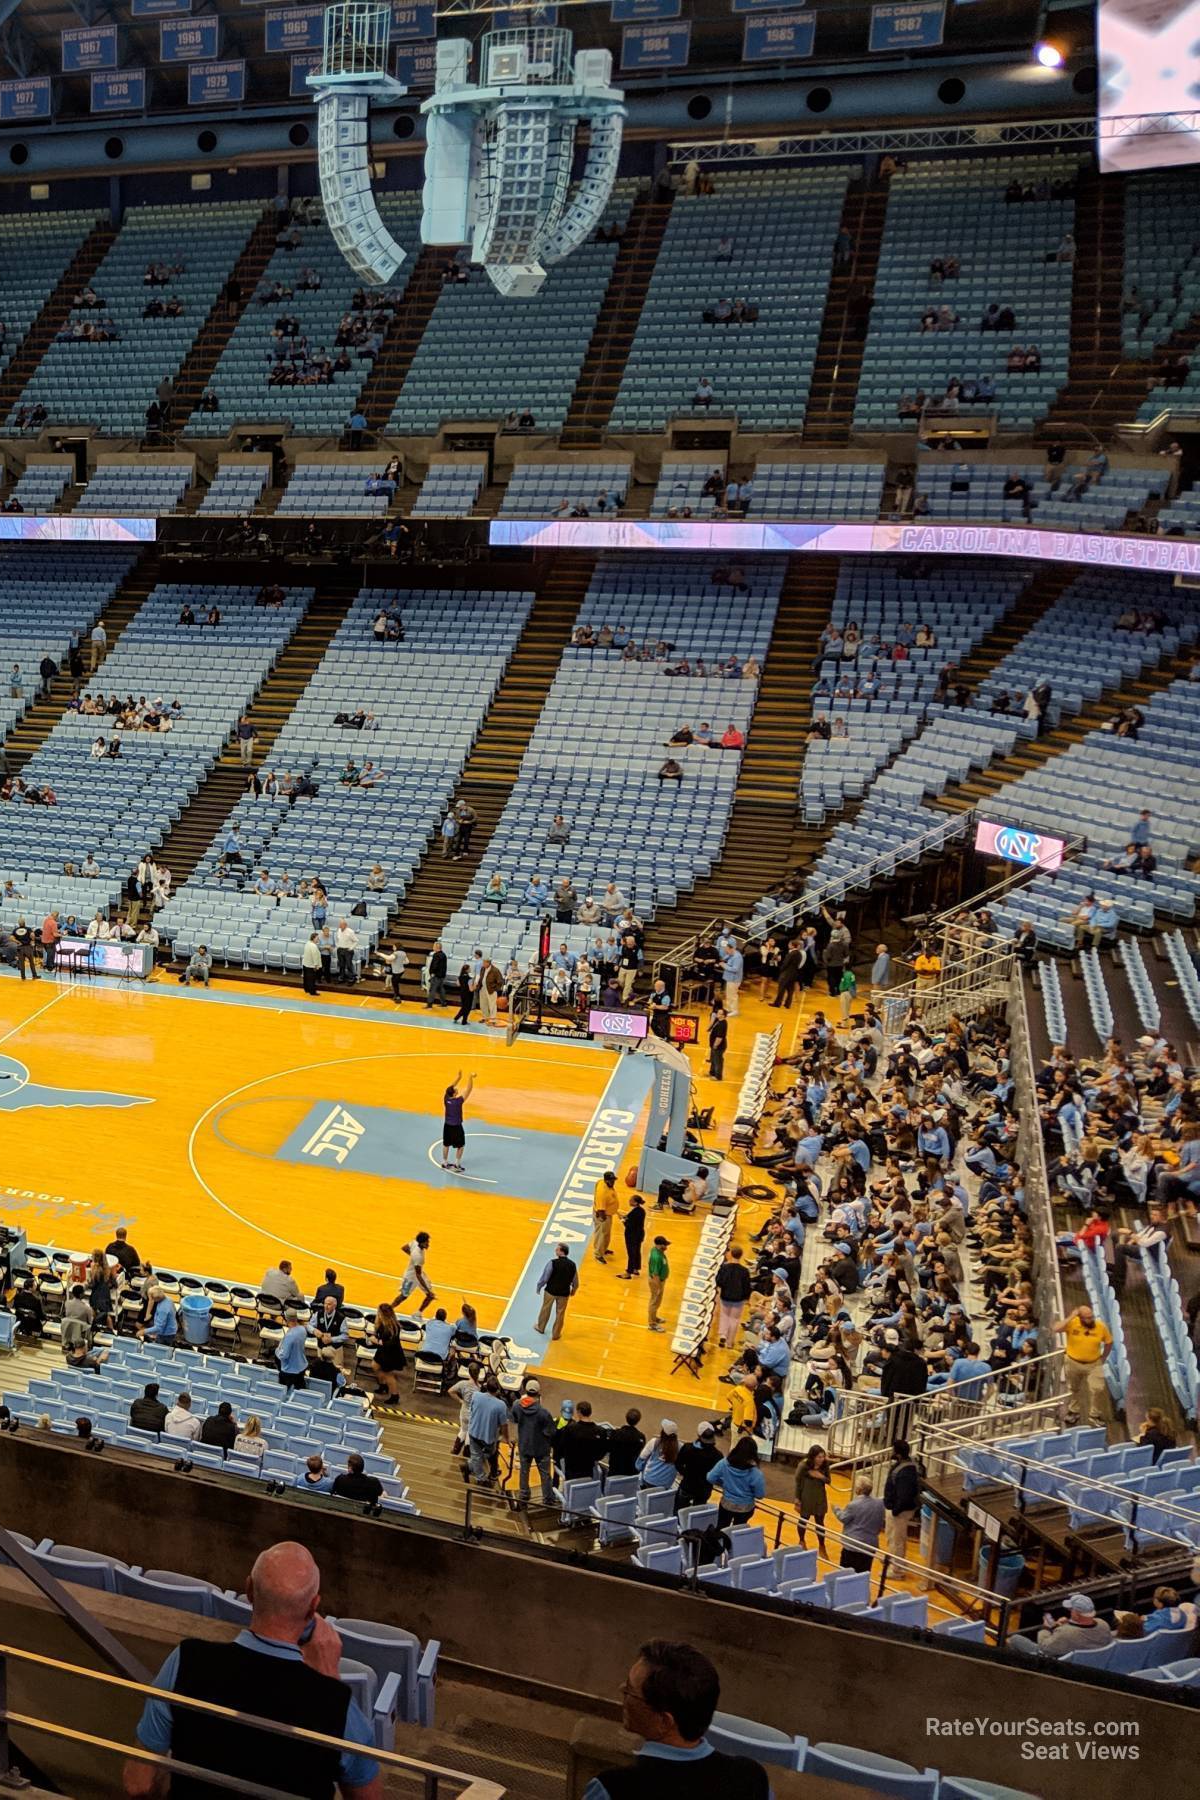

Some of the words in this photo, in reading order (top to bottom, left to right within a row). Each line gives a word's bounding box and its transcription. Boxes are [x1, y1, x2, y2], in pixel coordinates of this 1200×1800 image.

[395, 11, 416, 24] 1971
[163, 22, 176, 31] ACC
[283, 21, 308, 34] 1969
[894, 18, 922, 32] 1987
[767, 28, 794, 41] 1985
[206, 75, 228, 88] 1979
[16, 92, 34, 103] 1977
[901, 527, 1041, 555] CAROLINA
[308, 1108, 366, 1164] ACC
[544, 1108, 635, 1245] CAROLINA
